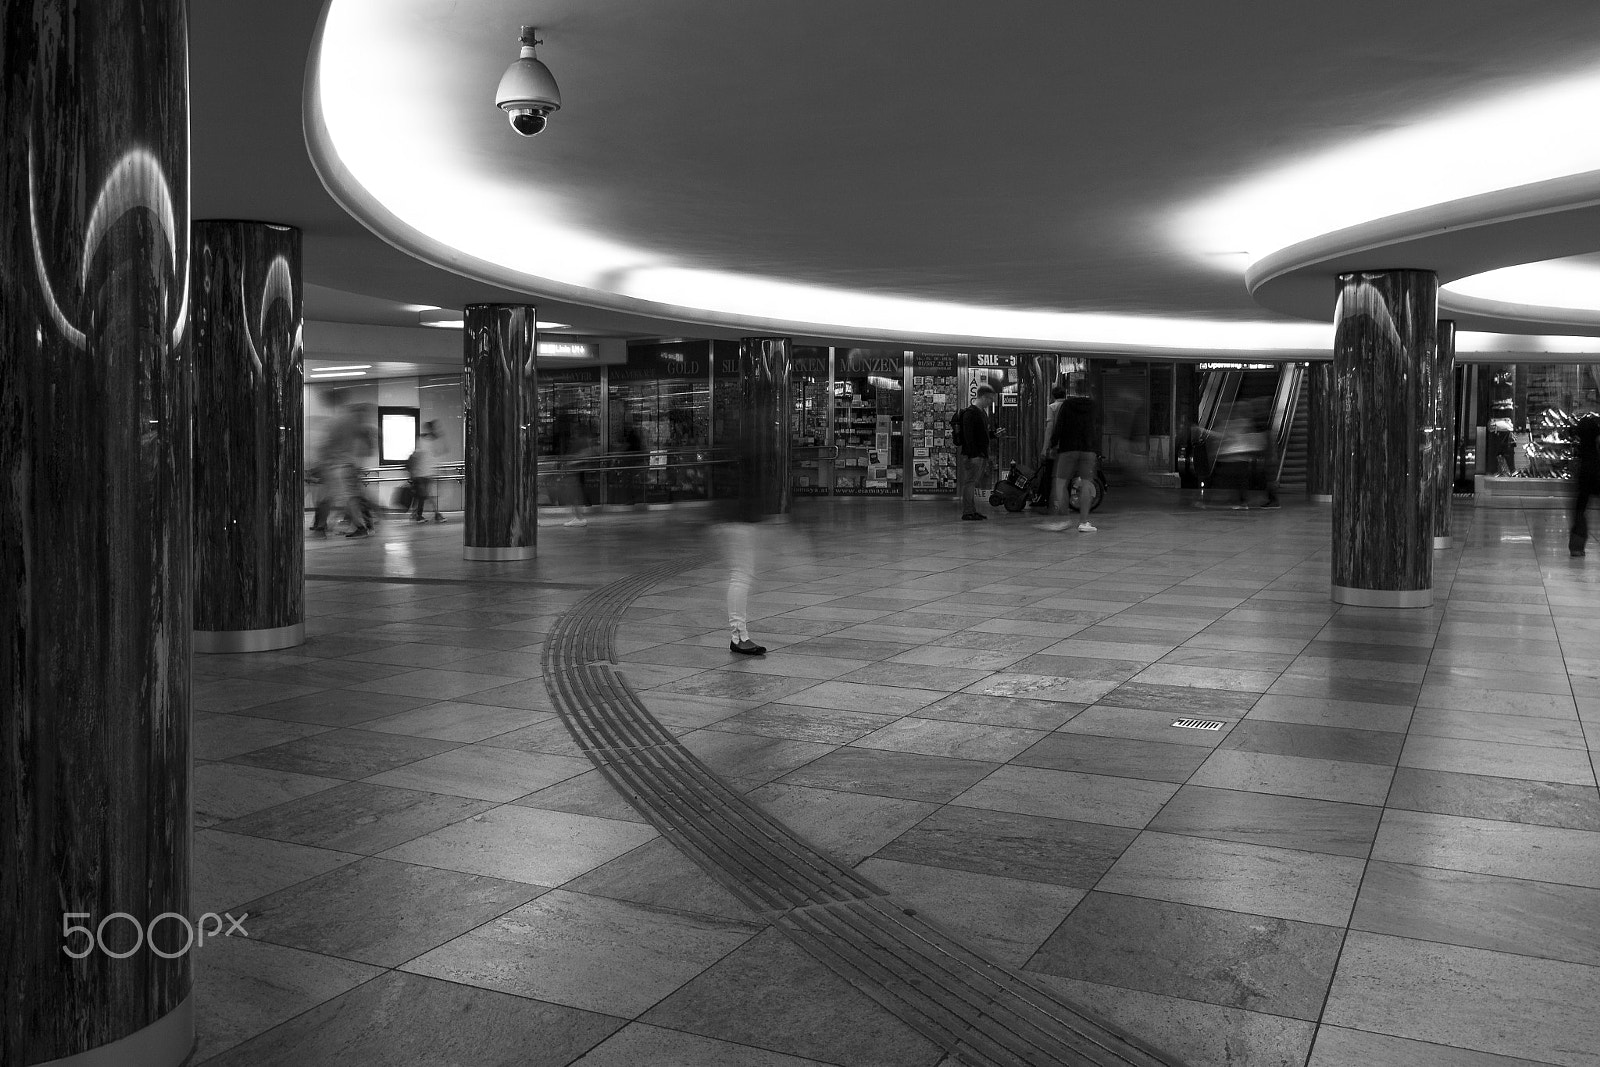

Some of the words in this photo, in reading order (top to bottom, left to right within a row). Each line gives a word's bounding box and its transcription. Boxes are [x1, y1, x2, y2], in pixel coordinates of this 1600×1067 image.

[722, 359, 739, 373] SIL
[792, 358, 827, 372] RKEN
[977, 353, 999, 366] SALE
[667, 361, 699, 375] GOLD
[969, 368, 979, 407] TASC
